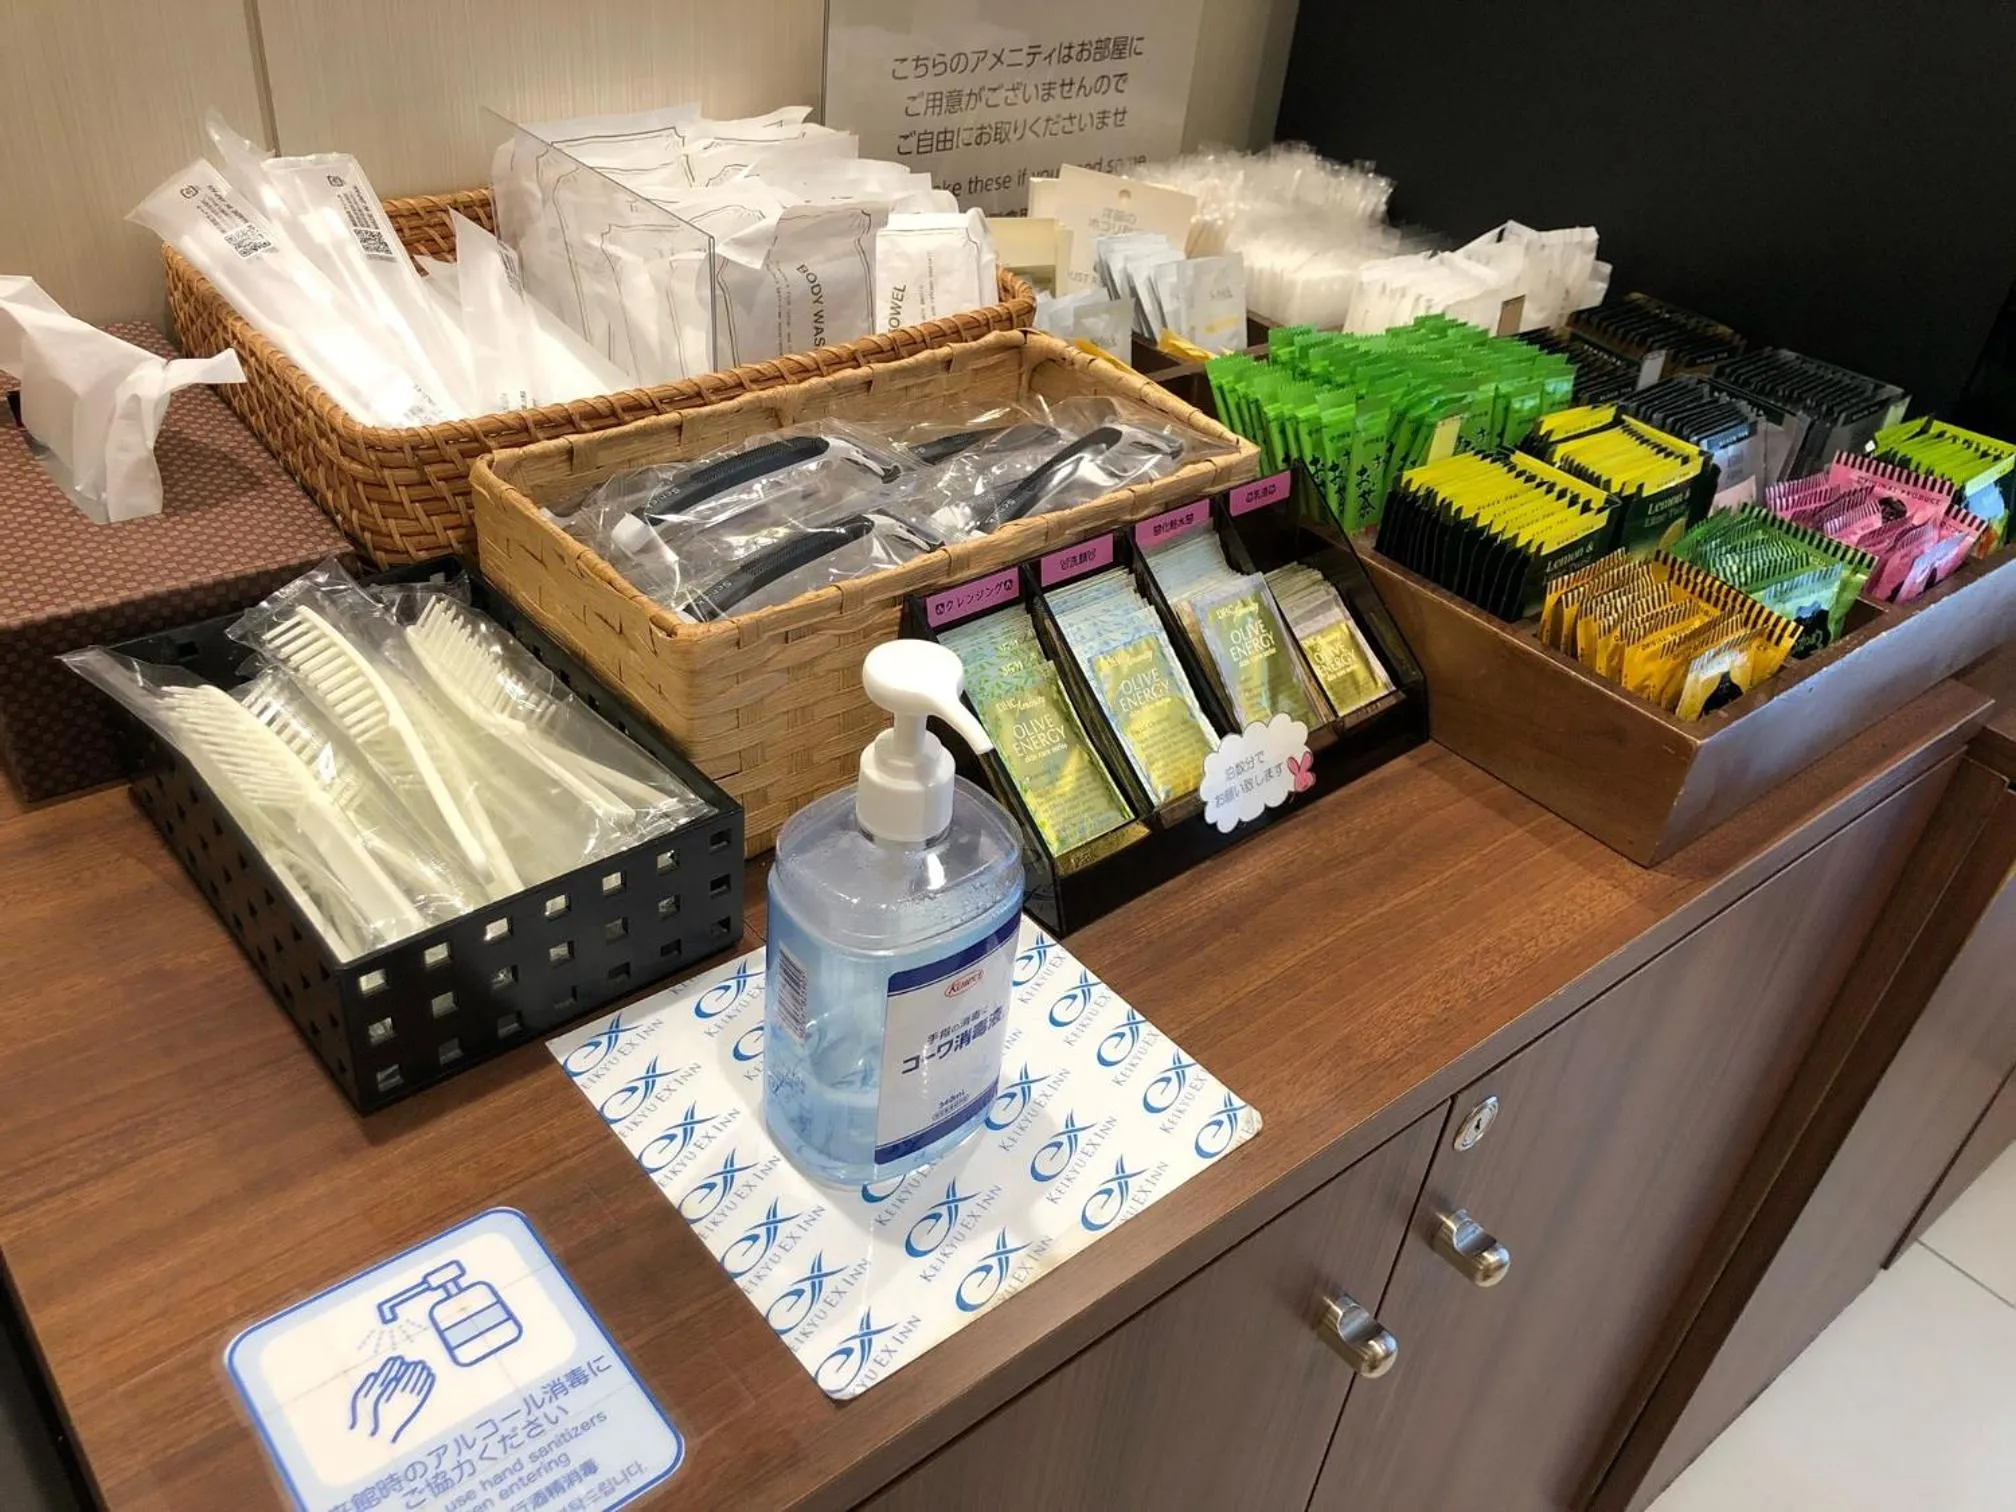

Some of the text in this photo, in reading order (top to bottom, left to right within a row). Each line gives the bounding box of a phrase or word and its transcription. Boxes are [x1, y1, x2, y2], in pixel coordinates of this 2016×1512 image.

[892, 35, 1146, 80] こちらのアメニティはお部屋に
[905, 72, 1129, 117] ご用意がございませんので
[897, 106, 1129, 156] ご自由にお取りくださいませ
[968, 175, 1012, 194] these
[1017, 168, 1028, 188] if
[796, 264, 826, 349] BODY WAS
[887, 284, 907, 334] OWEL
[945, 583, 1003, 611] クレンジング
[1229, 631, 1275, 662] ENERGY
[1230, 618, 1267, 644] OLIVE
[1120, 680, 1169, 712] ENERGY
[1121, 668, 1160, 694] OLIVE
[1013, 714, 1054, 740] OLIVE
[1013, 724, 1066, 757] ENERGY
[581, 1056, 620, 1090] EIKYU
[636, 1018, 665, 1041] INN
[1049, 1068, 1071, 1092] INN
[618, 1104, 658, 1139] EIKYU
[673, 1062, 702, 1086] INN
[1094, 1115, 1117, 1140] INN
[657, 1151, 697, 1189] EIKYU
[712, 1107, 741, 1132] INN
[1146, 1161, 1169, 1187] INN
[699, 1200, 738, 1241] EIKYU
[752, 1155, 782, 1181] INN
[978, 1185, 1003, 1211] INN
[742, 1252, 781, 1295] EIKYU
[797, 1204, 826, 1232] INN
[1029, 1236, 1054, 1262] INN
[788, 1309, 828, 1354] EIKYU
[843, 1257, 872, 1287] INN
[892, 1315, 922, 1345] INN
[403, 1404, 569, 1511] ご協力ください
[445, 1411, 608, 1512] use hand sanitizers
[498, 1452, 571, 1500] entering
